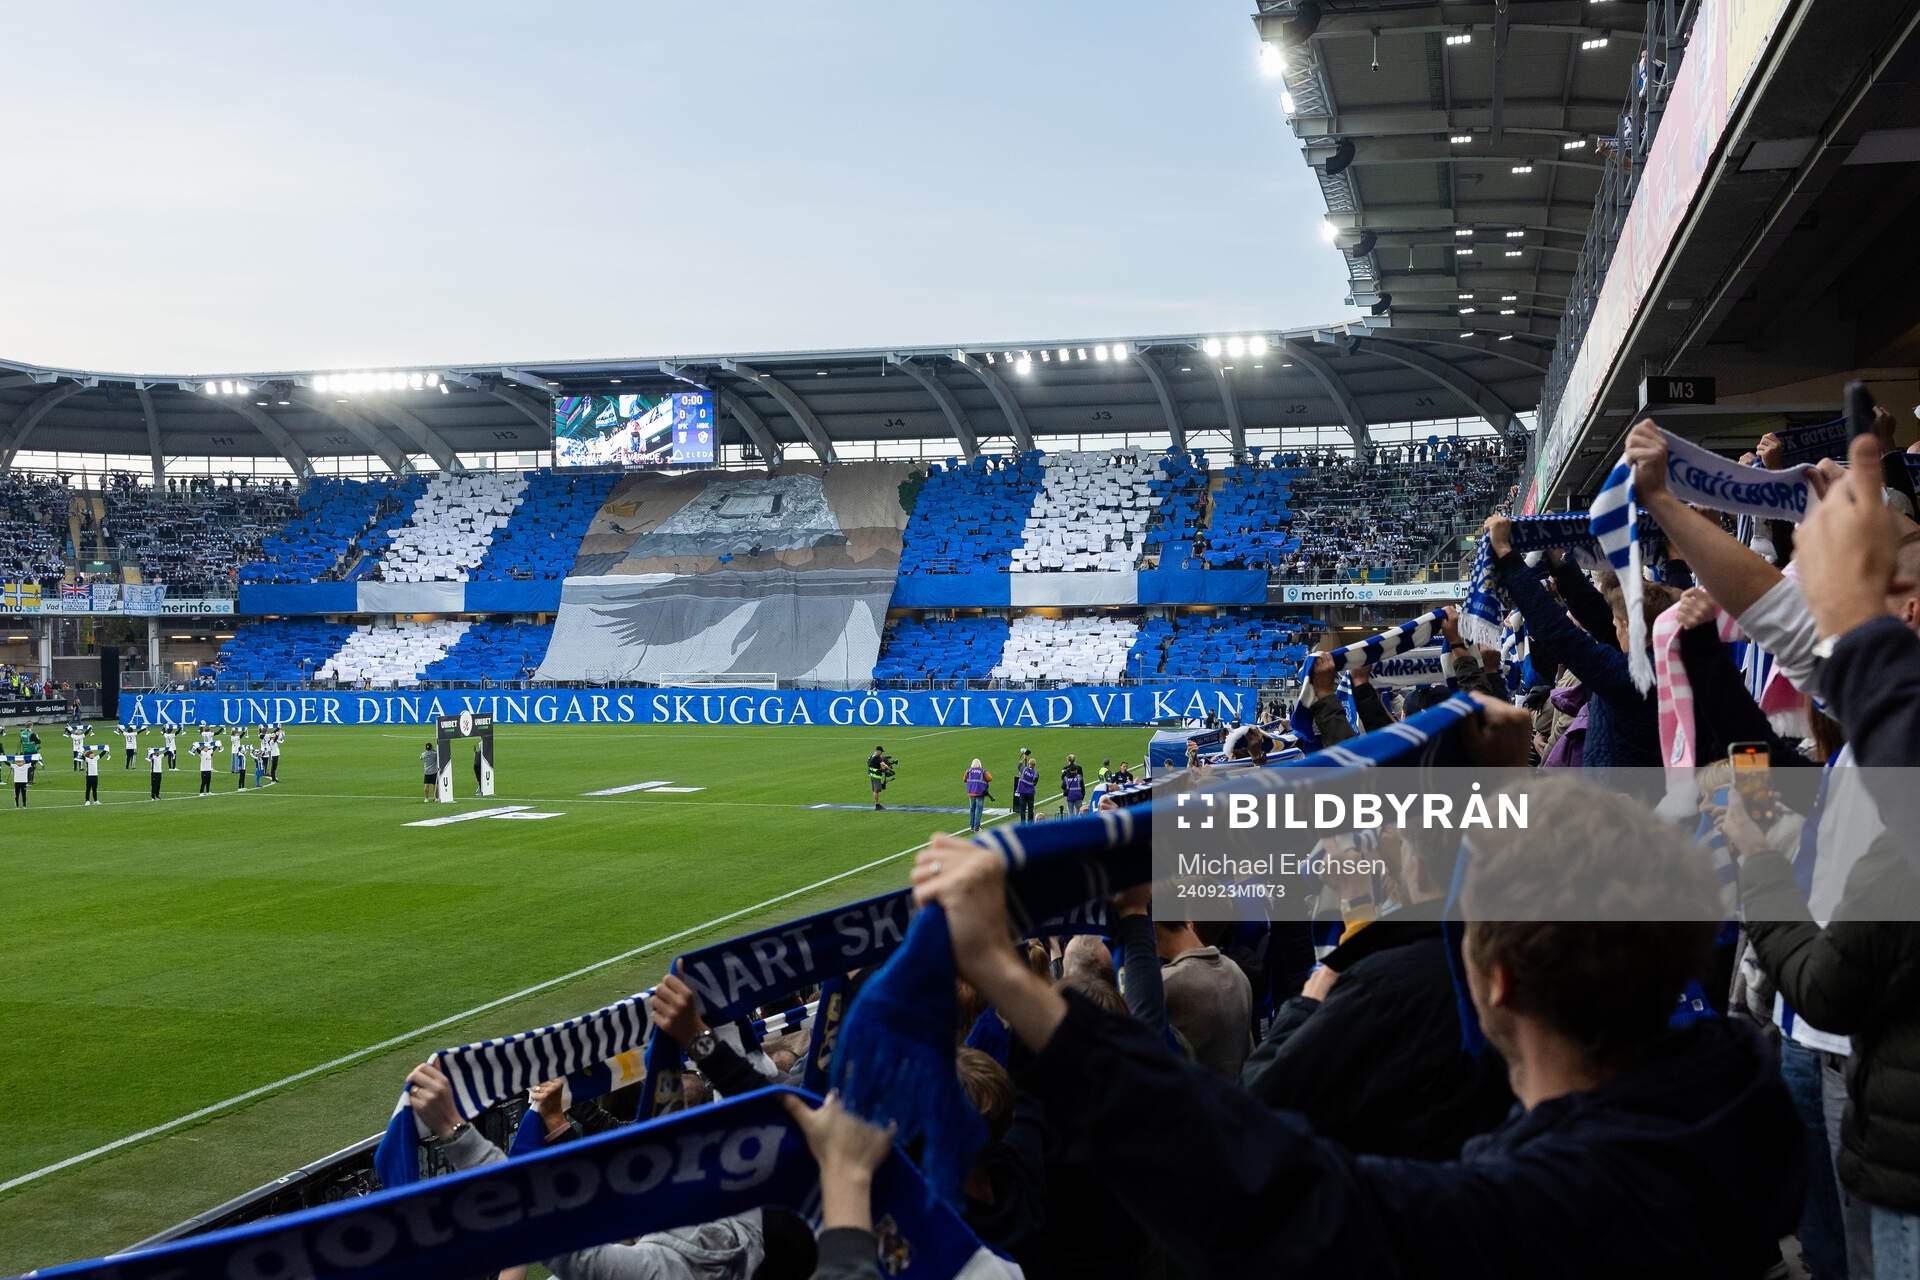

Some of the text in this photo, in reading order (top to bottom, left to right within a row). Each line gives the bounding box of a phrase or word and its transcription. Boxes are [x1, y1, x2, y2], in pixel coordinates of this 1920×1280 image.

[1669, 382, 1695, 399] M3
[681, 395, 703, 406] 0:00
[1285, 404, 1308, 414] J2
[1091, 411, 1113, 421] J3
[884, 418, 905, 428] J4
[492, 431, 518, 441] H3
[211, 437, 235, 446] H1
[686, 451, 714, 459] ELEDA
[1301, 587, 1373, 600] merinfo.se
[1378, 589, 1392, 597] Vad
[161, 601, 230, 613] merinfo.se
[219, 696, 344, 725] UNDER
[356, 695, 447, 724] DINA
[461, 695, 635, 724] VINGARS
[652, 694, 814, 725] SKUGGA
[829, 690, 914, 726] GÖR
[929, 696, 973, 726] VI
[988, 695, 1073, 728] VAD
[1088, 693, 1134, 723] VI
[1152, 688, 1245, 721] KAN
